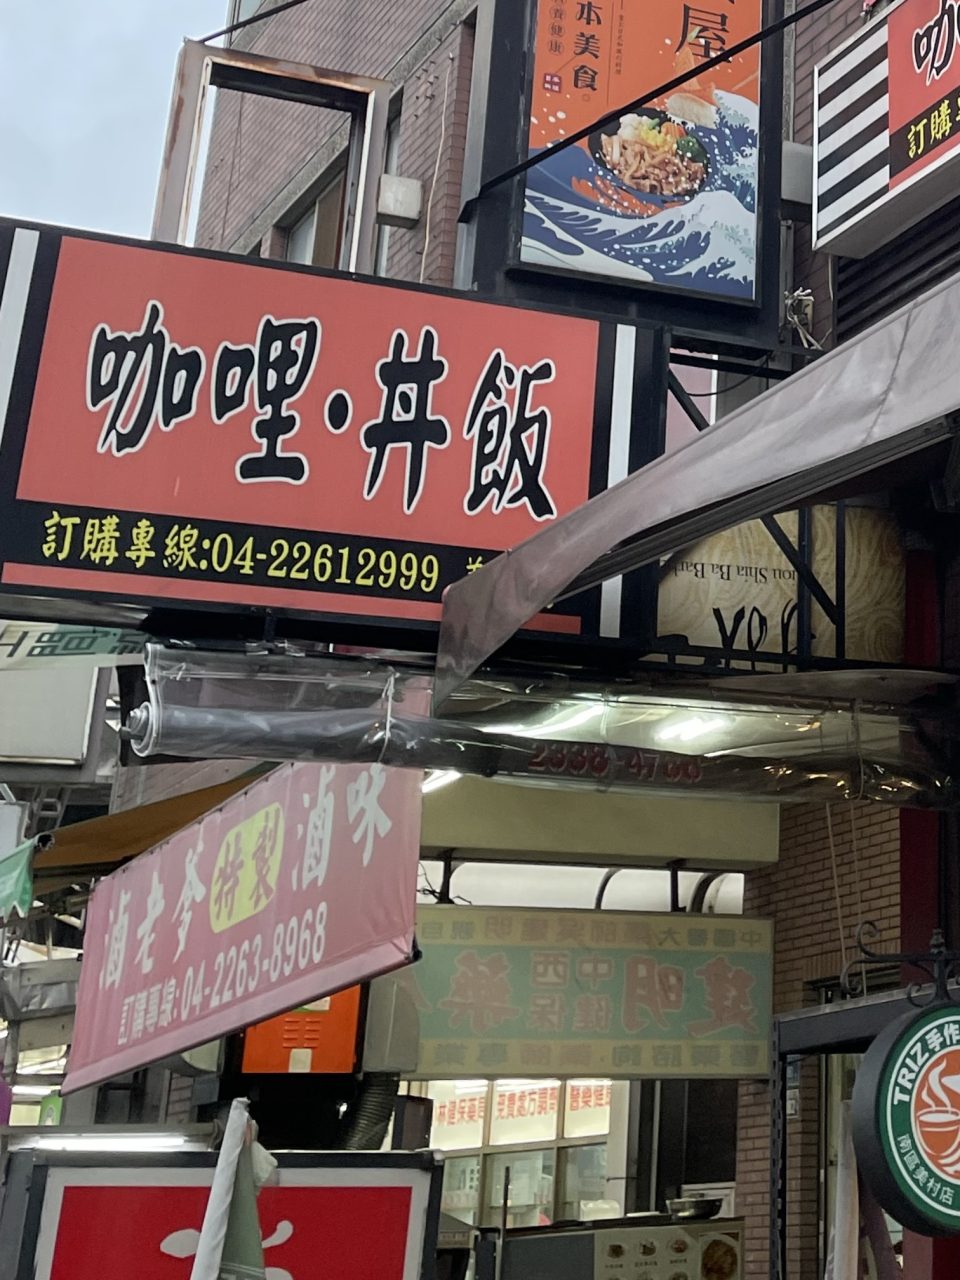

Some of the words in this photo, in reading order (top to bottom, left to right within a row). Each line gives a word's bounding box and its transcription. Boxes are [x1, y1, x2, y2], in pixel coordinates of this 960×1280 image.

[41, 509, 440, 594] 訂購專線:04-22612999
[290, 763, 394, 894] 滷味
[897, 1133, 955, 1206] 南區美村店
